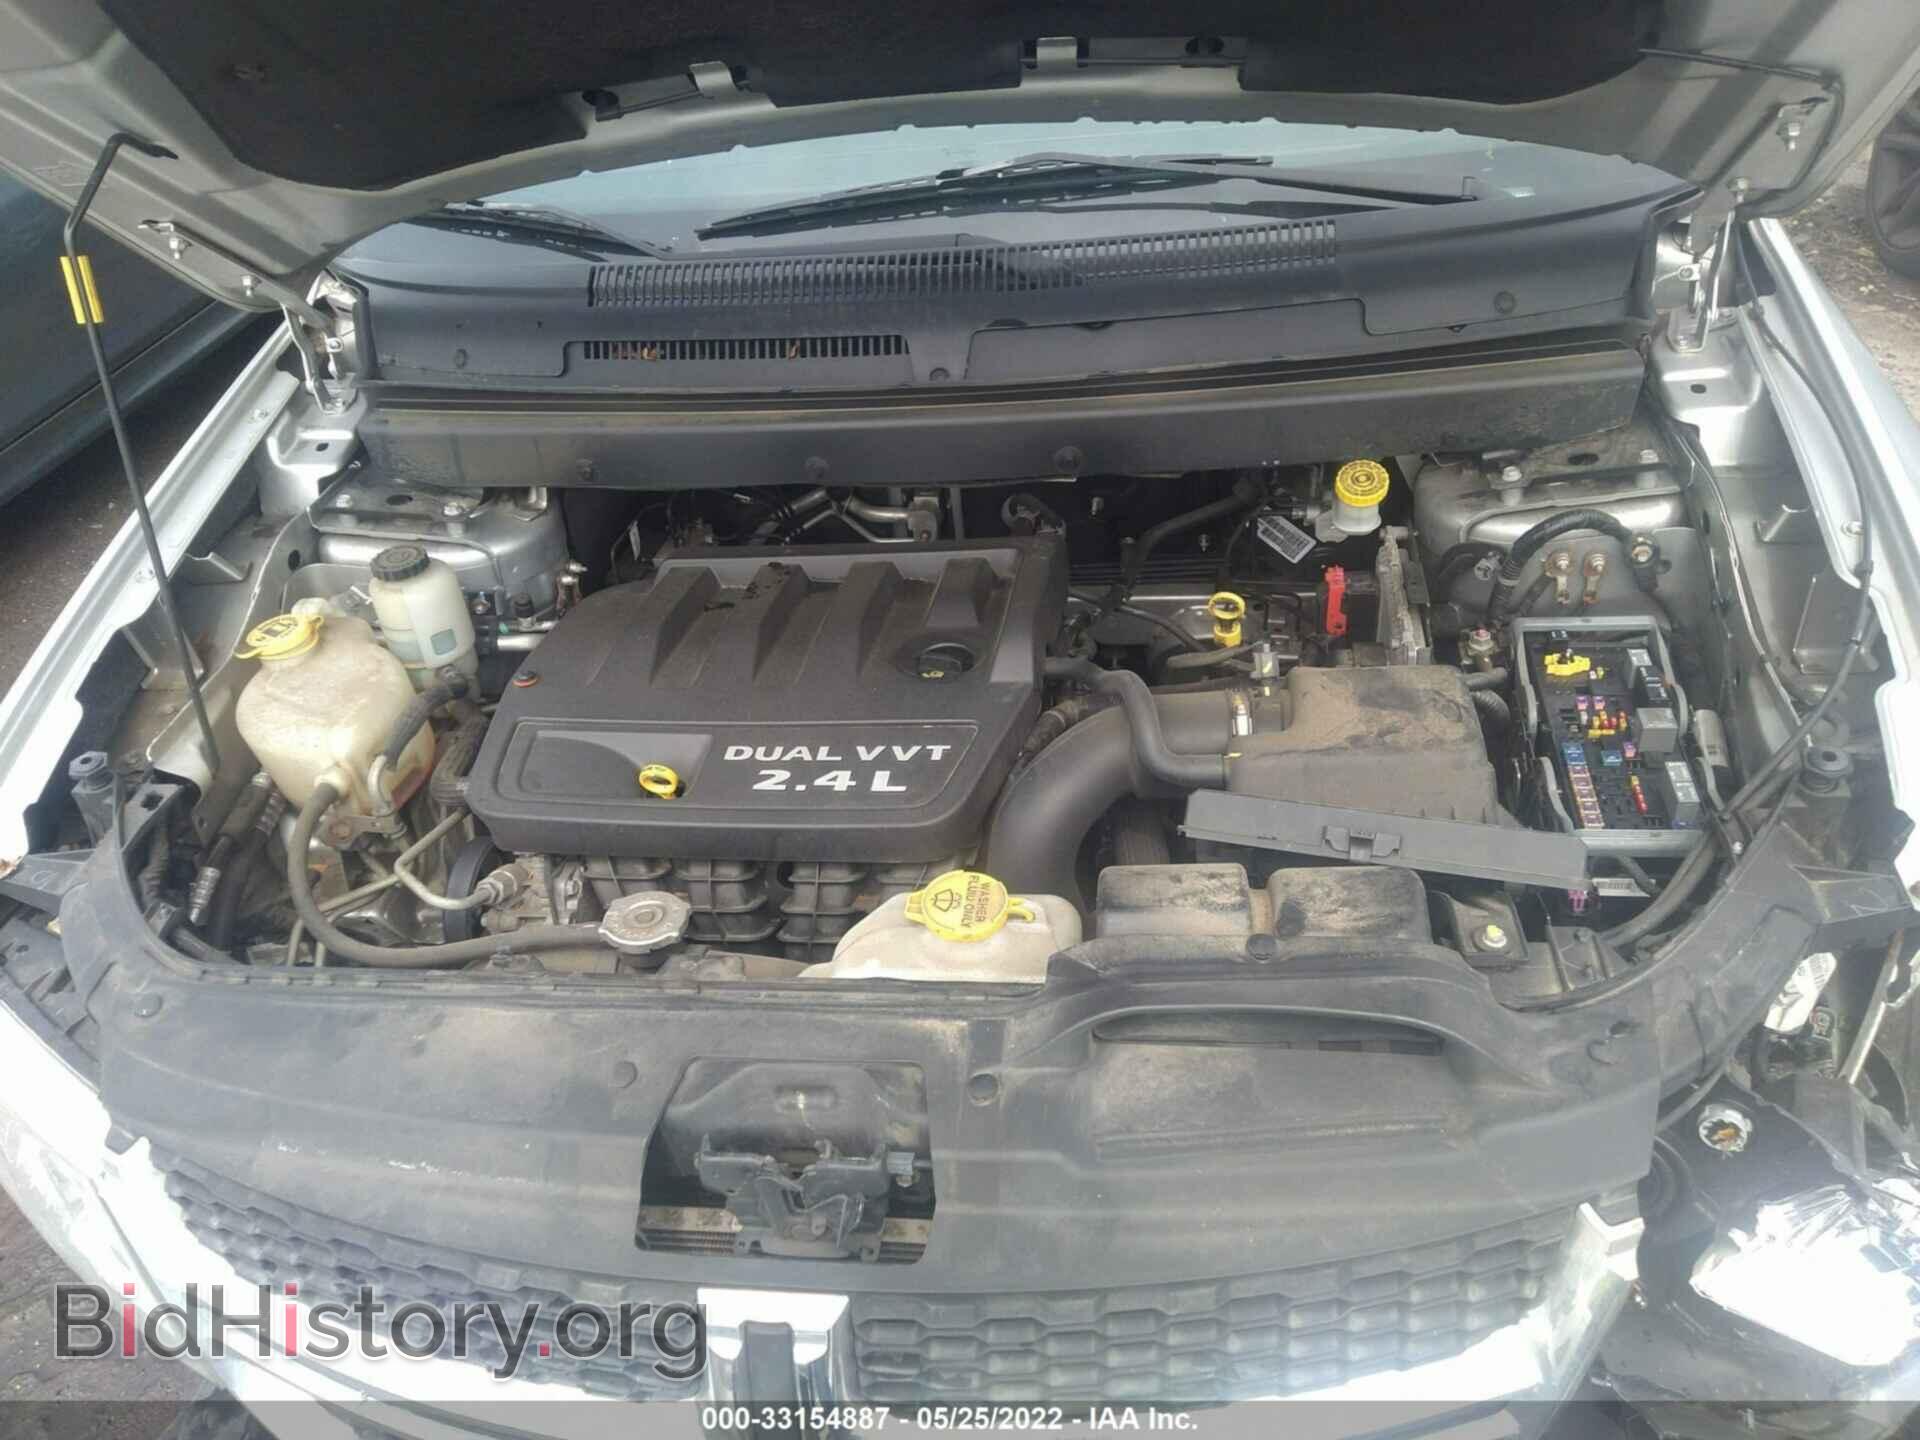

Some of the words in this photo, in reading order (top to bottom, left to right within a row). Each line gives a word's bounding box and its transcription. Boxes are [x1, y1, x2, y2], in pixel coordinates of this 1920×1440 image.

[723, 745, 843, 761] DUAL
[855, 745, 952, 761] VVT
[752, 769, 857, 791] 2.4
[870, 770, 907, 792] L
[965, 874, 980, 901] FLUID
[974, 881, 991, 922] WASHER
[960, 903, 976, 928] ONLY
